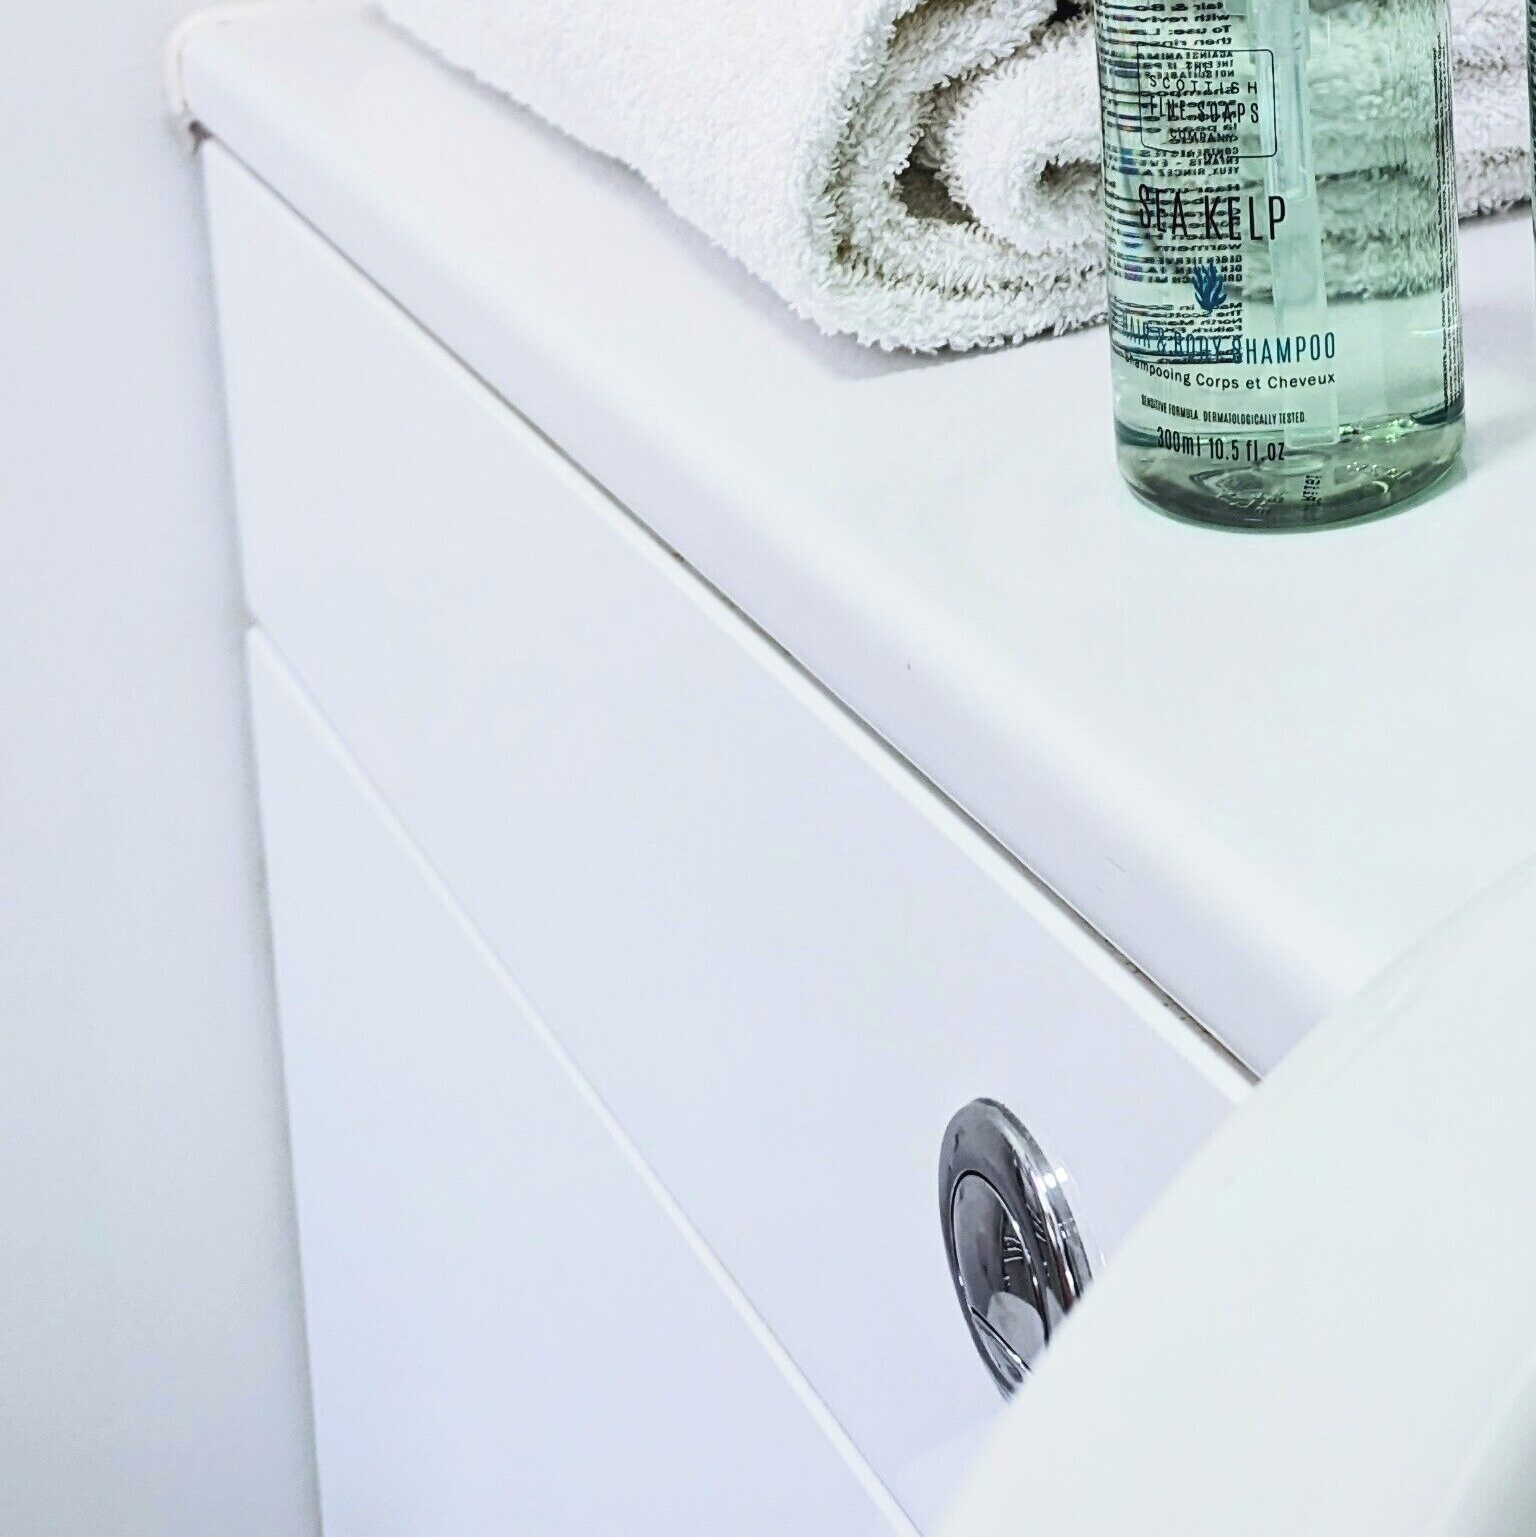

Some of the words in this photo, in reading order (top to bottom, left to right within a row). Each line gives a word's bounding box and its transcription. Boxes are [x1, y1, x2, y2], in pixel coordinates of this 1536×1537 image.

[1149, 75, 1258, 95] SCOTTISH
[1138, 183, 1188, 240] SEA
[1204, 194, 1286, 241] KELP
[1231, 331, 1336, 365] SHAMPOO
[1196, 373, 1240, 389] Corps
[1245, 377, 1262, 390] et
[1268, 373, 1336, 389] Cheveux
[1203, 410, 1277, 426] DERMATOLOGICALLY
[1156, 426, 1201, 457] 300ml
[1208, 437, 1240, 461] 10.5
[1246, 439, 1286, 462] fl.oz
